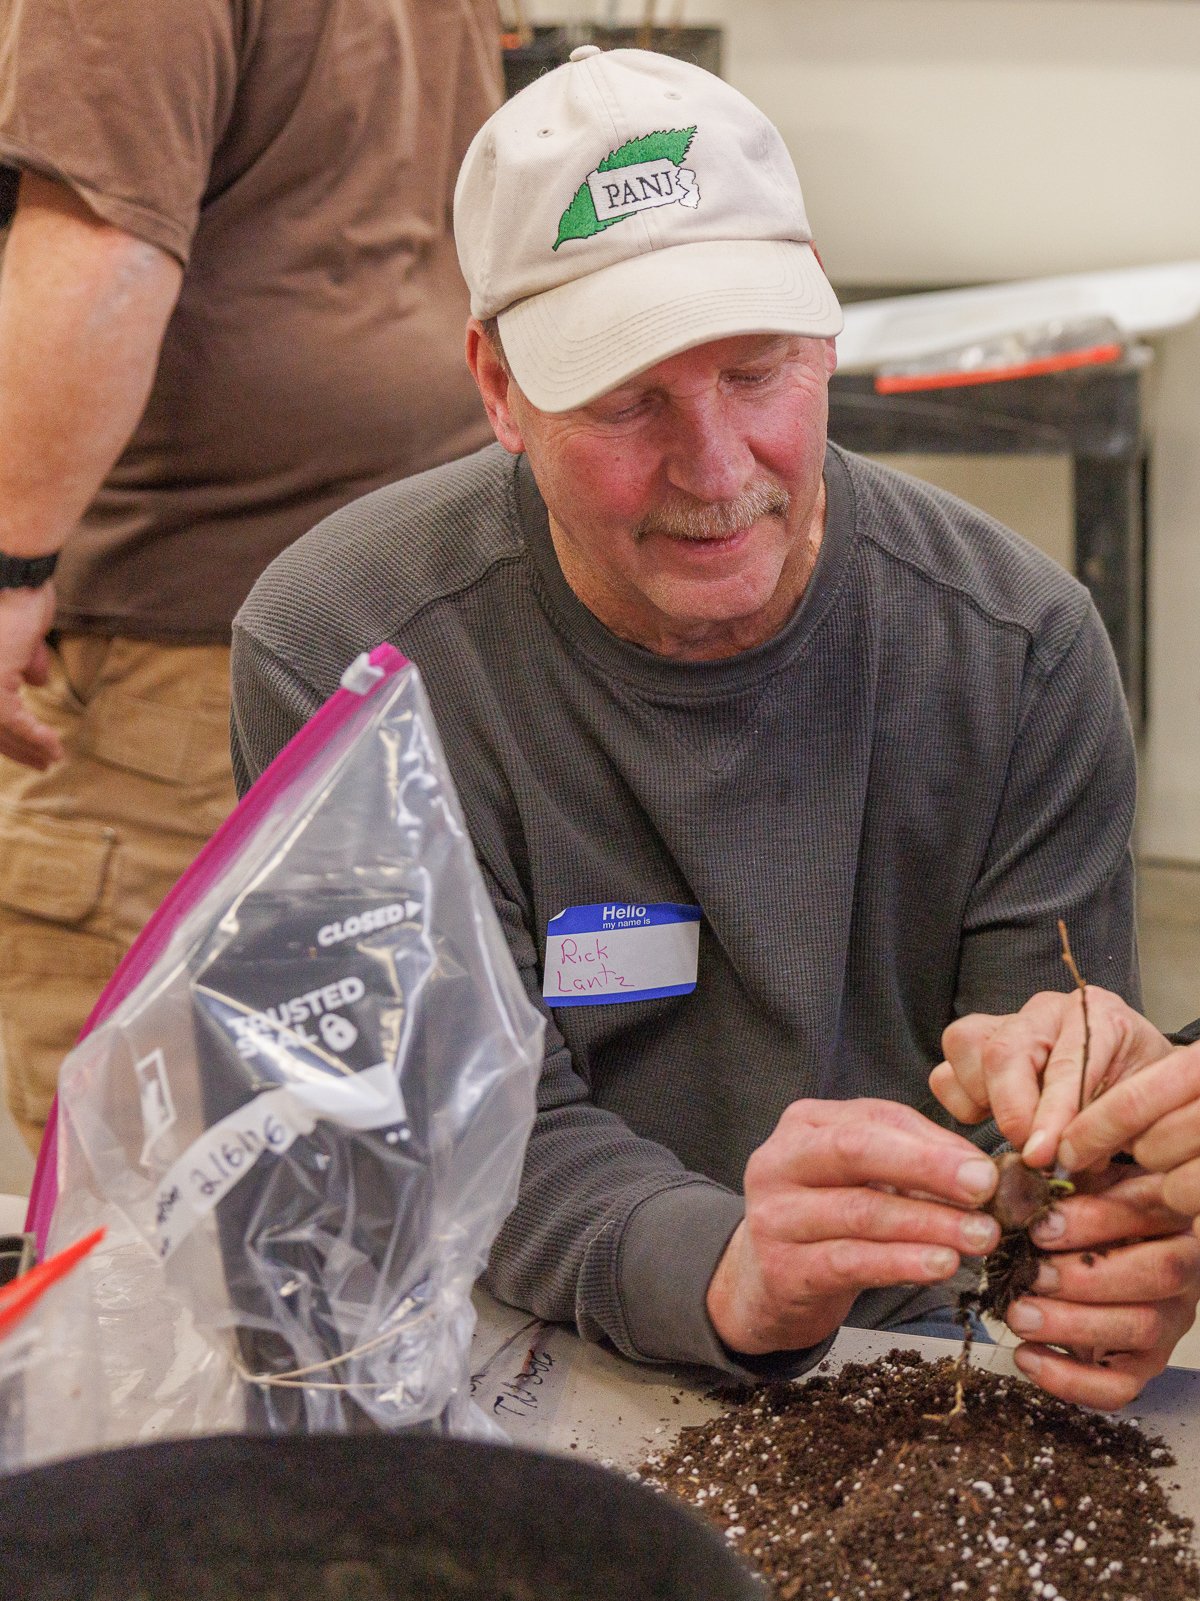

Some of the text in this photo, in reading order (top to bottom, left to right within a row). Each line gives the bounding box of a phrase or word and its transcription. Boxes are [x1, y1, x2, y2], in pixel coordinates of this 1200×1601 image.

[602, 171, 673, 209] PANJ
[317, 903, 404, 947] CLOSED
[602, 905, 647, 920] Hello
[602, 916, 651, 930] my name is
[560, 938, 609, 965] Rick
[557, 963, 635, 993] Lantz
